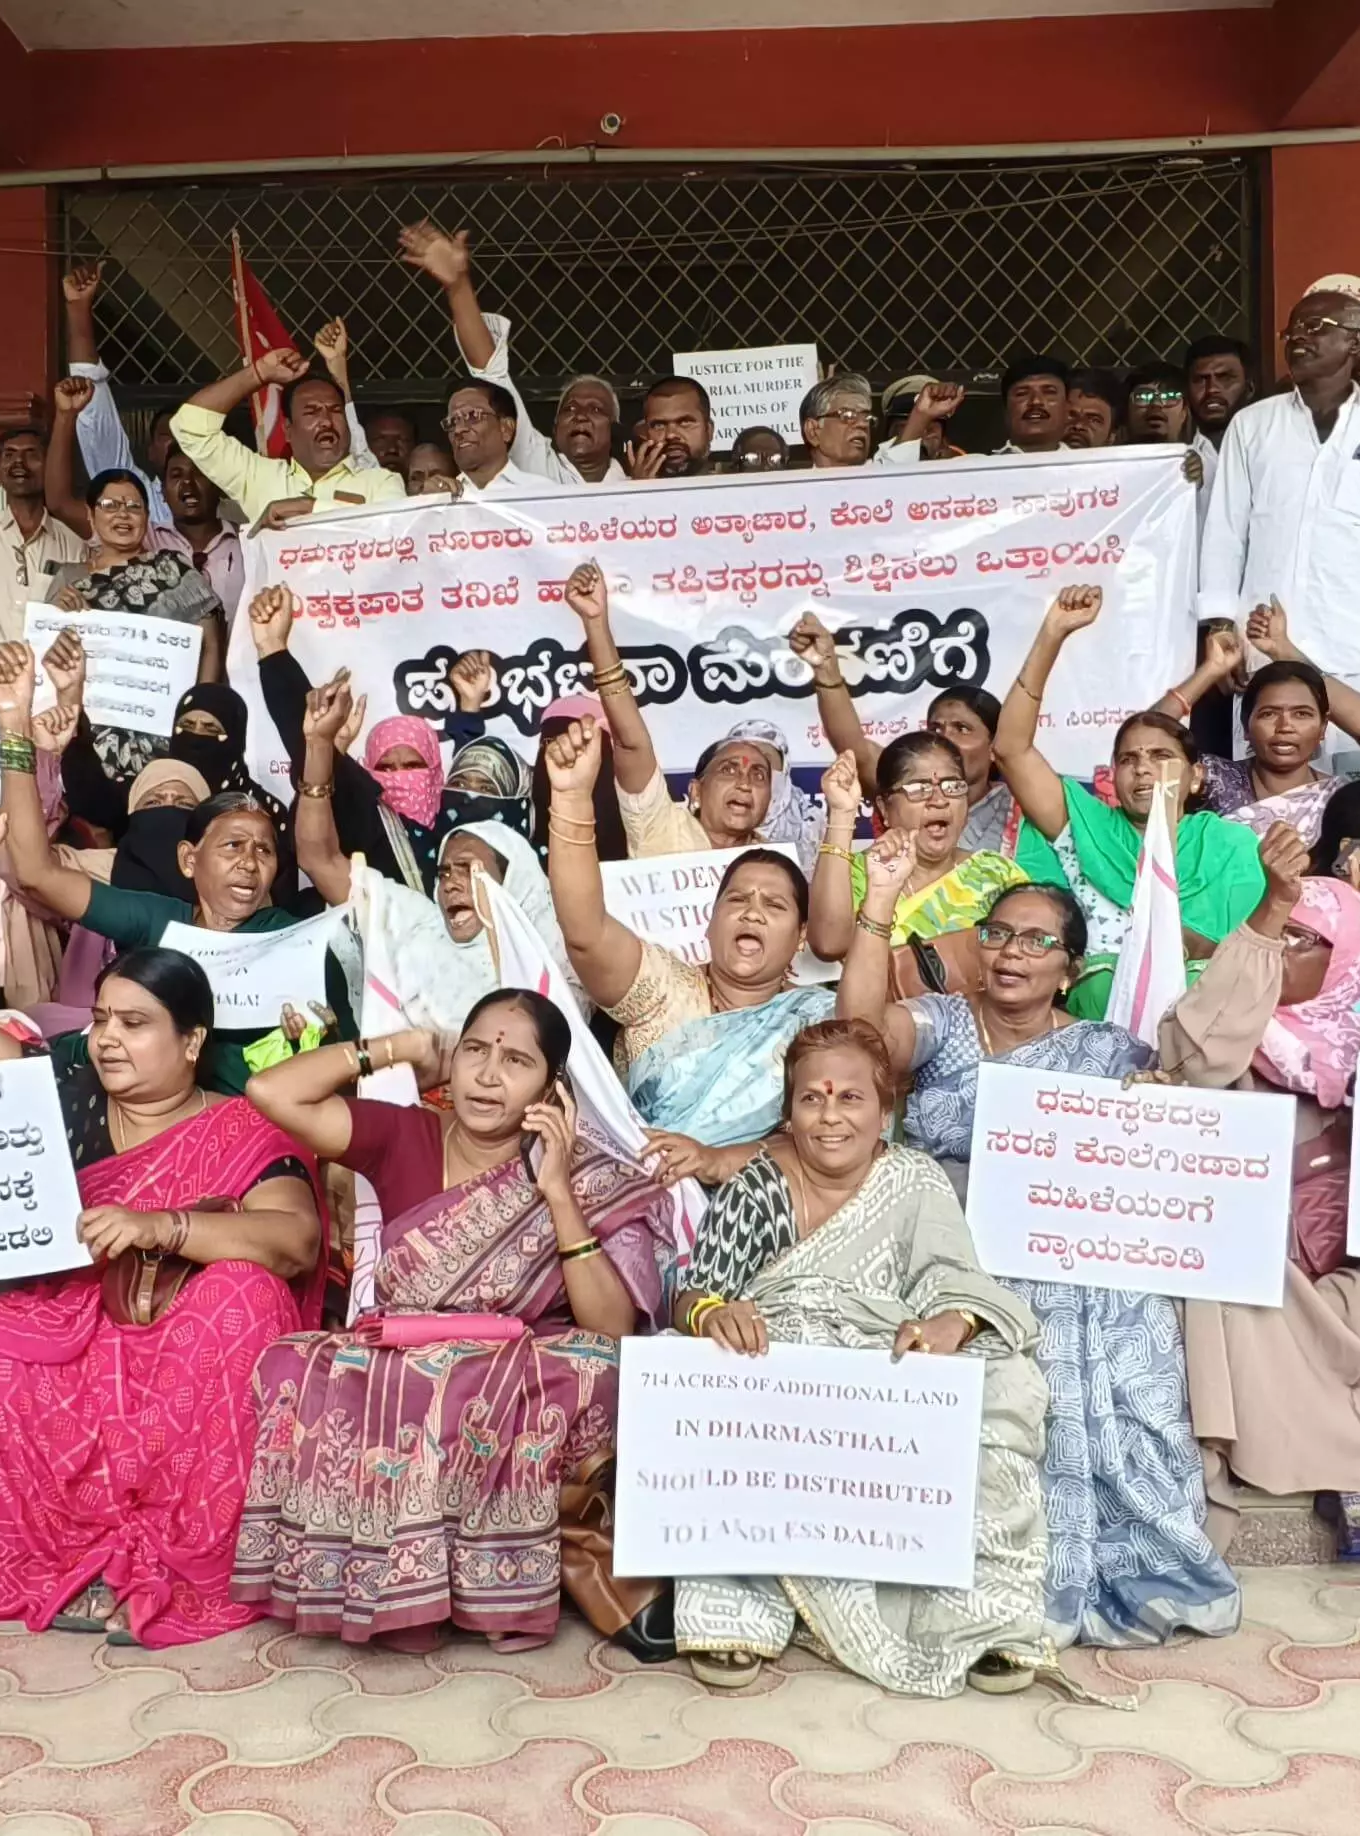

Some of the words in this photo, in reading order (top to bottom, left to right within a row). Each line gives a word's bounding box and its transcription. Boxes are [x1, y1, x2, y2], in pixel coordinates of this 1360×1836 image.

[689, 361, 743, 376] JUSTICE
[746, 359, 774, 373] FOR
[776, 355, 805, 369] THE
[709, 381, 742, 397] RIAL
[743, 378, 803, 393] MURDER
[711, 402, 768, 417] VICTIMS
[771, 401, 789, 413] OF
[278, 535, 418, 576] ಧರ್ಮಸ್ಥಳದಲ್ಲಿ
[428, 524, 533, 558] ನೂರಾರು
[546, 513, 677, 543] ಮಹಿಳೆಯರ
[831, 499, 894, 527] ಕೊಲೆ
[907, 493, 999, 520] ಅಸಹಜ
[441, 574, 520, 611] ತನಿಖೆ
[621, 871, 665, 898] WE
[1035, 1083, 1222, 1138] ಧರ್ಮಸ್ಥಳದಲ್ಲಿ
[986, 1125, 1058, 1159] ಸರಣಿ
[1074, 1136, 1271, 1180] ಕೊಲೆಗೀಡಾದ
[1027, 1178, 1215, 1224] ಮಹಿಳೆಯರಿಗೆ
[1027, 1230, 1206, 1272] ನ್ಯಾಯಕೊಡಿ
[640, 1371, 670, 1388] 714
[674, 1372, 738, 1390] ACRES
[744, 1376, 771, 1393] OF
[772, 1378, 900, 1404] ADDITIONAL
[904, 1388, 959, 1408] LAND
[675, 1418, 701, 1439] IN
[707, 1419, 921, 1456] DHARMASTHALA
[745, 1470, 777, 1489] BE
[784, 1472, 953, 1507] DISTRIBUTED
[660, 1522, 694, 1545] TO
